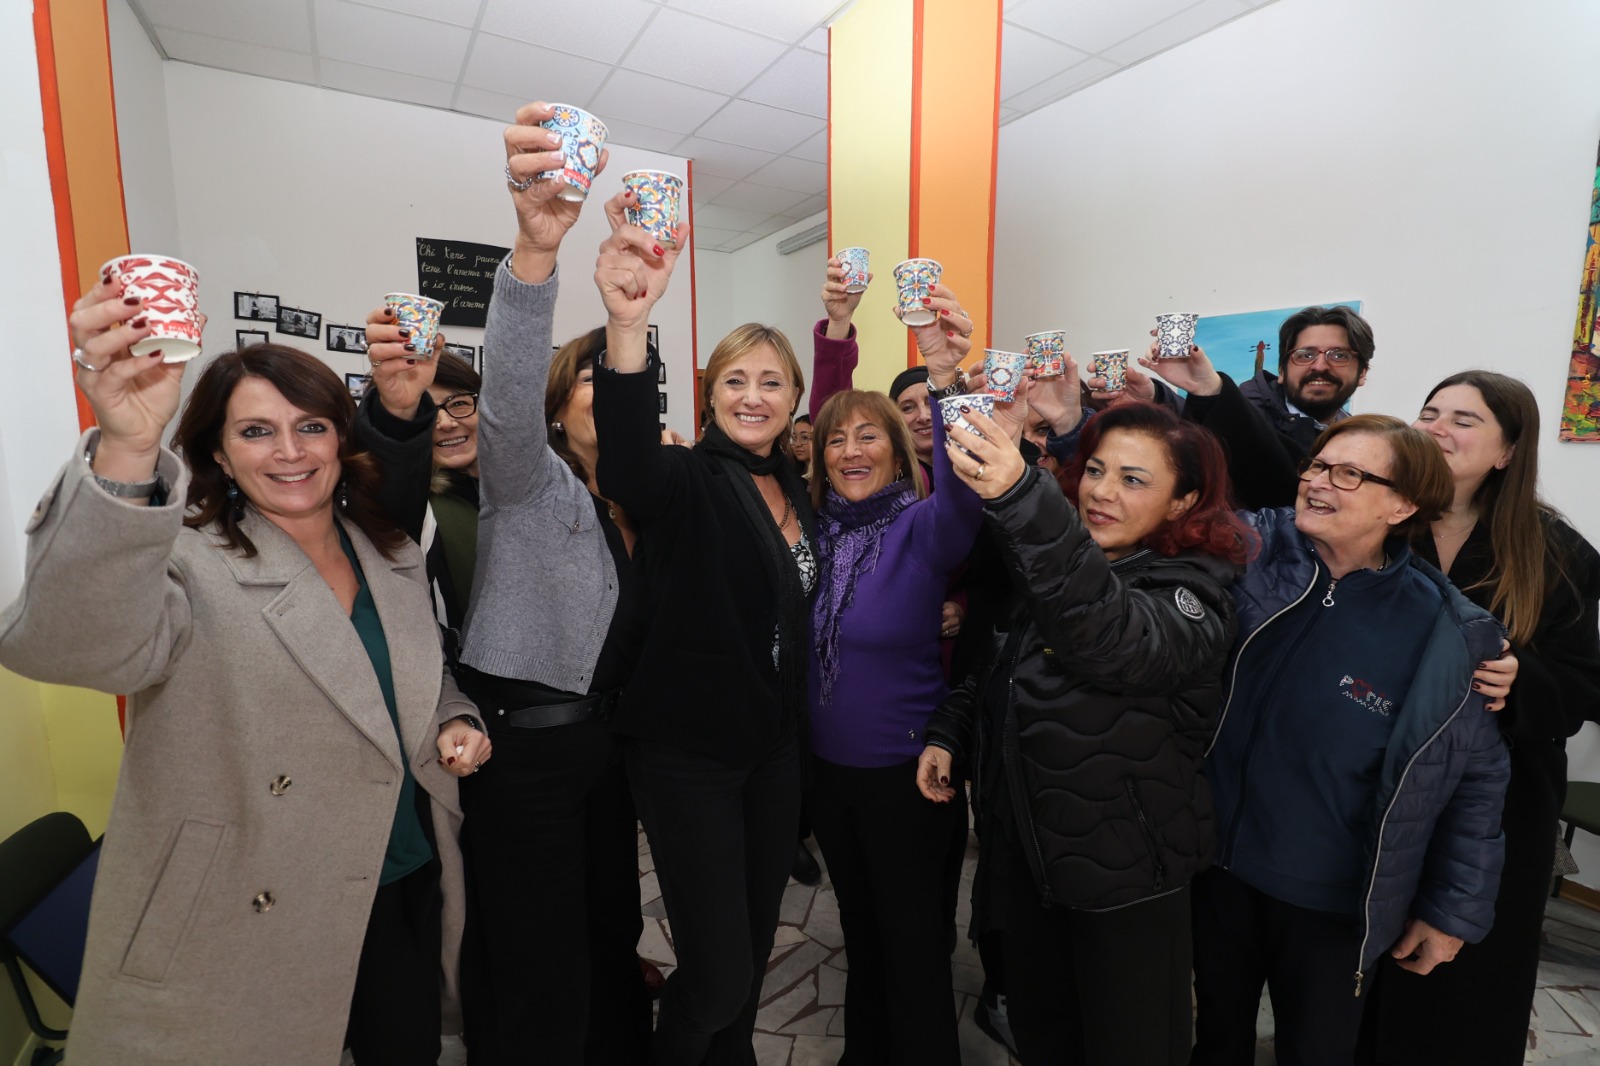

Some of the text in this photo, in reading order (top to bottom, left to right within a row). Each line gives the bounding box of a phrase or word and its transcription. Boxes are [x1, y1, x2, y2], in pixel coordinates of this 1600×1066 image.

[444, 246, 467, 260] tene
[421, 261, 442, 273] tene
[422, 280, 429, 288] e
